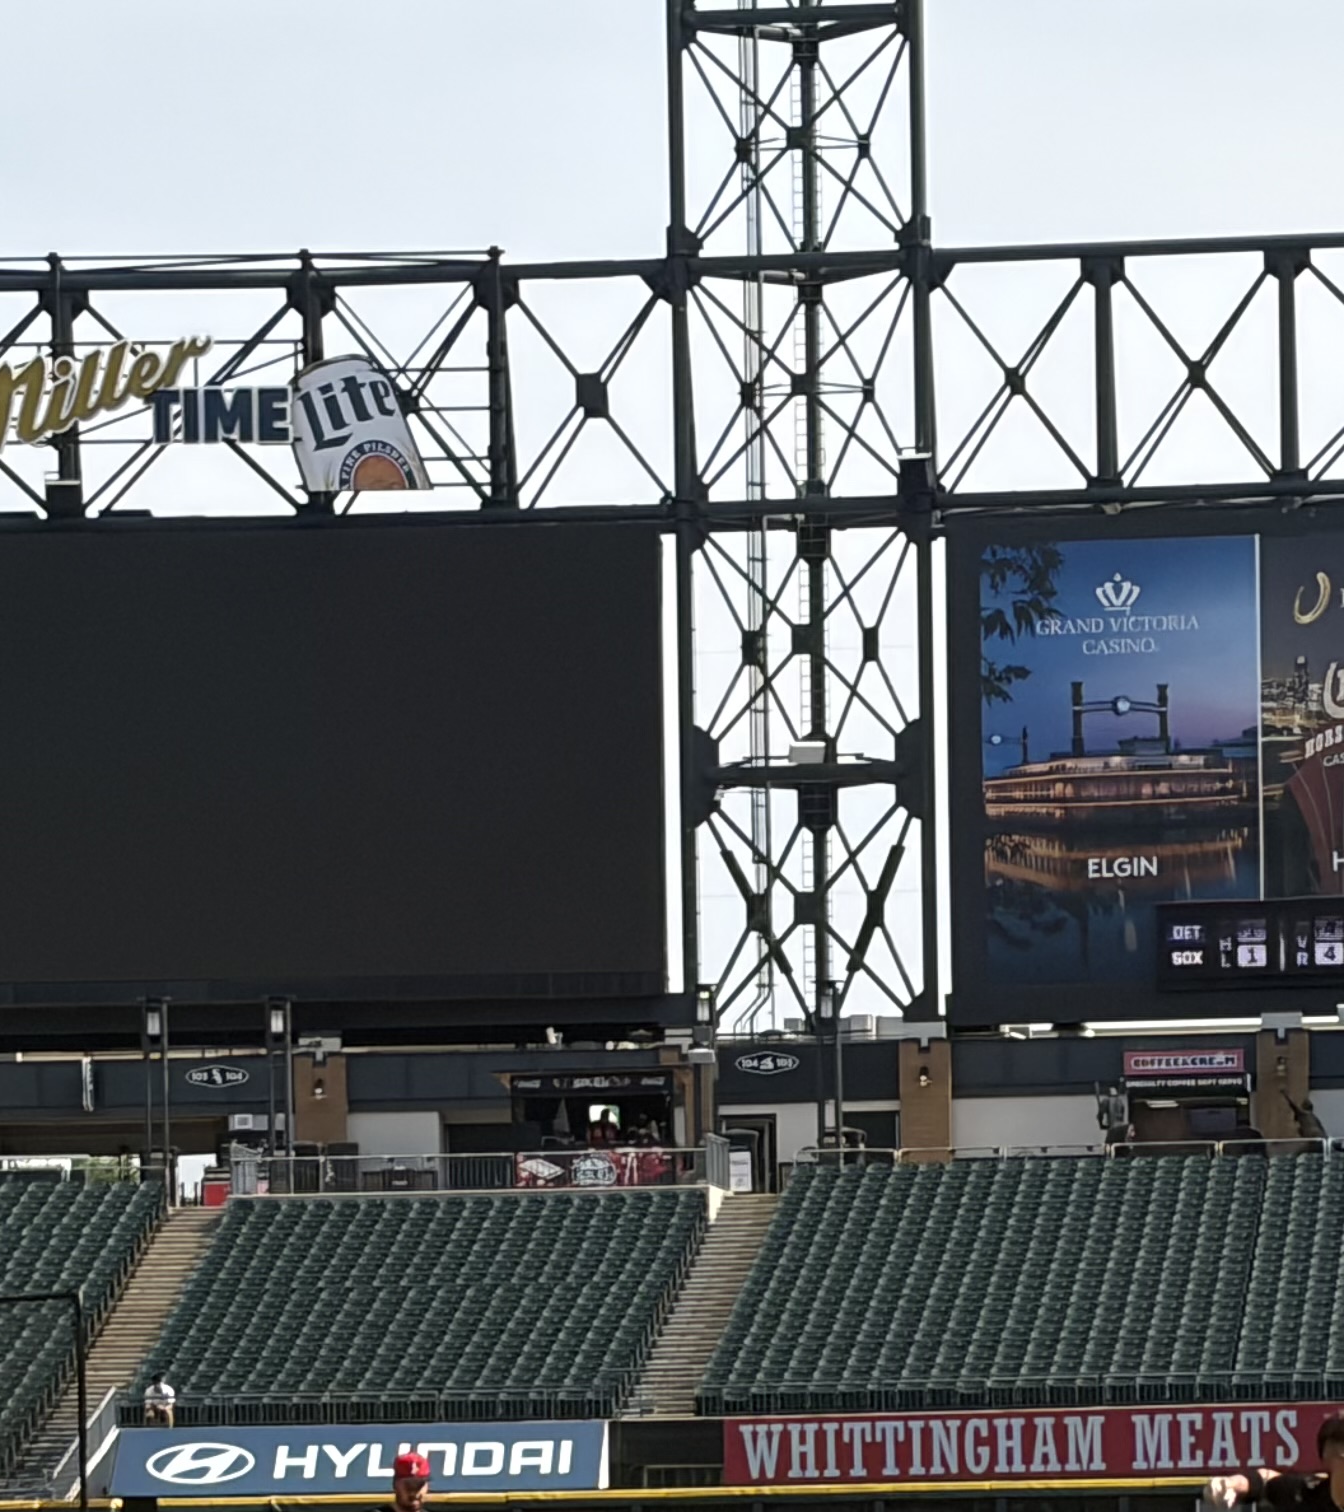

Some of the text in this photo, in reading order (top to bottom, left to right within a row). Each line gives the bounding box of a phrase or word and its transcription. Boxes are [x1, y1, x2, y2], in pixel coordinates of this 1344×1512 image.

[152, 388, 293, 443] TIME
[296, 375, 396, 452] Lite
[1036, 613, 1200, 636] GRAND VICTORIA
[1082, 637, 1155, 655] CASINO
[1087, 857, 1158, 878] ELGIN
[1172, 925, 1202, 940] DET
[1171, 950, 1204, 965] SOX
[739, 1409, 1300, 1480] WHITTINGHAM MEATS
[273, 1440, 574, 1479] HYUNDAI
